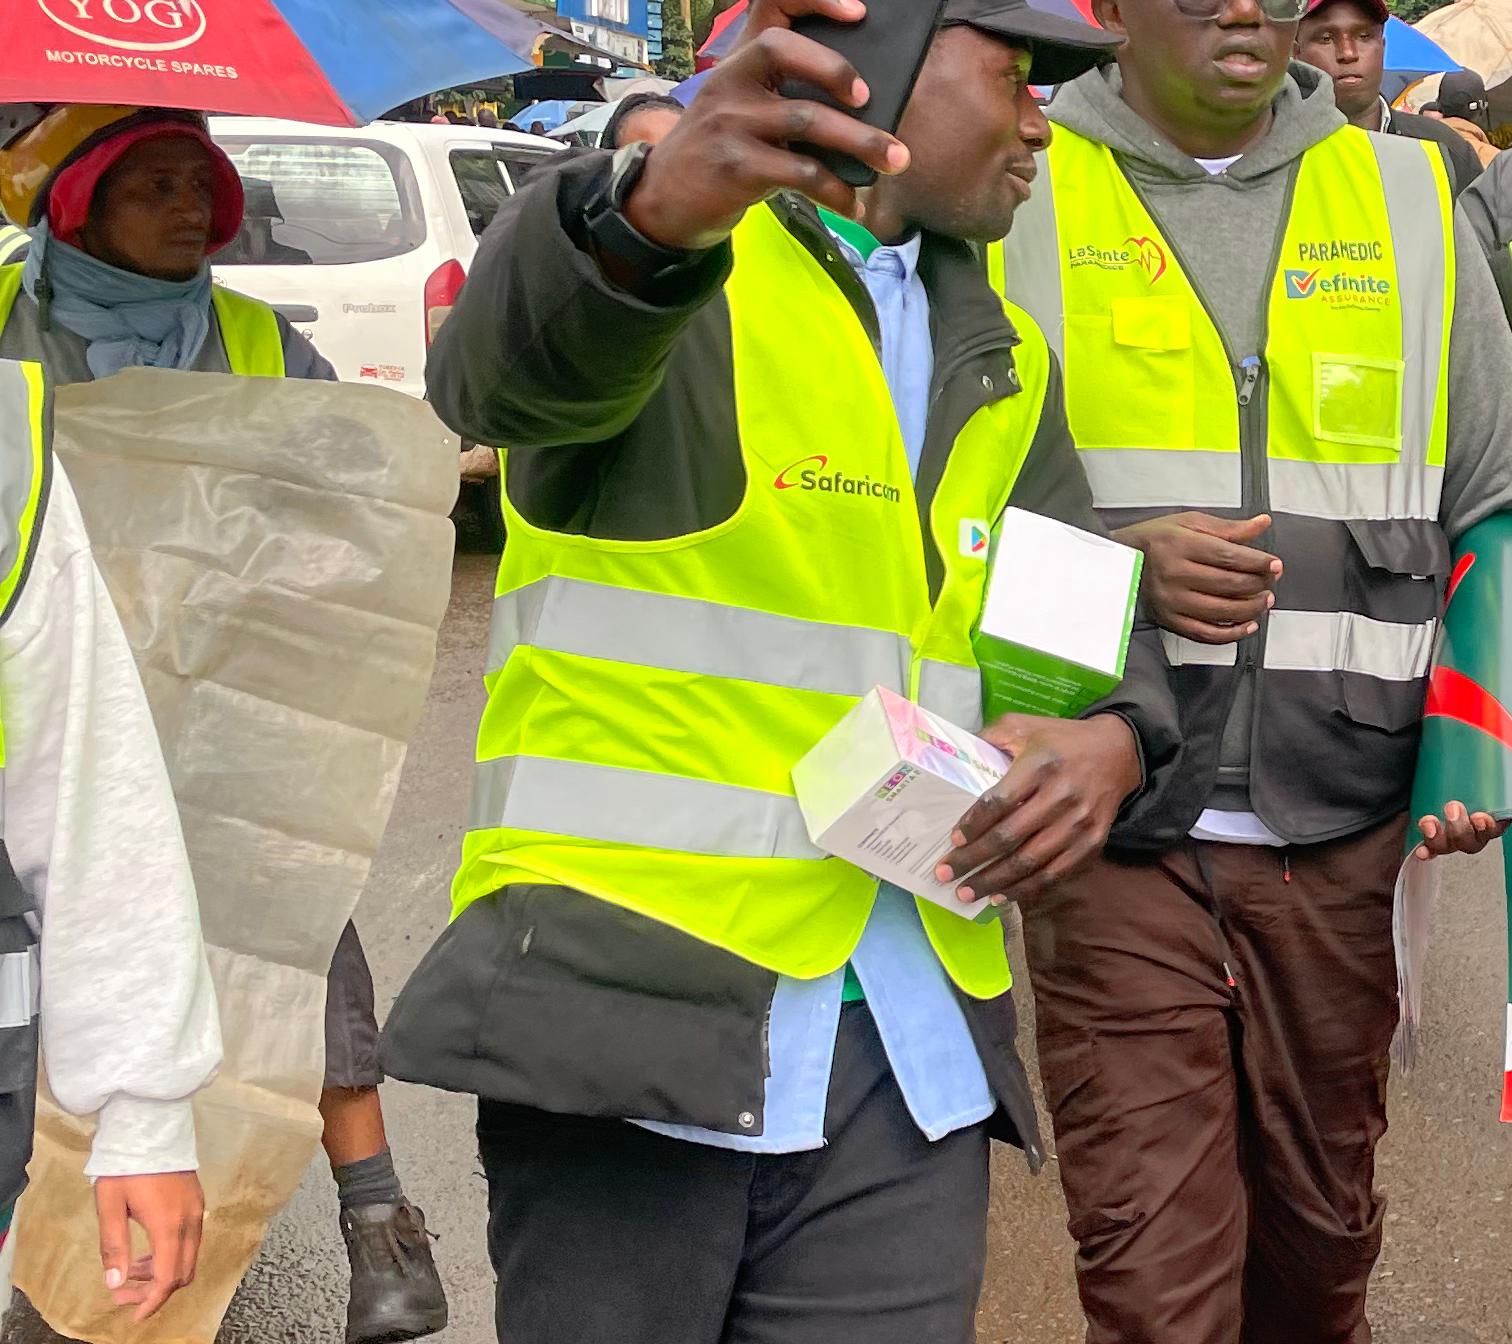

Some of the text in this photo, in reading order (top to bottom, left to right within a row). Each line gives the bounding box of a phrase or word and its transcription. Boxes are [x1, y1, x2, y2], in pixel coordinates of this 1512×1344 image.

[45, 49, 239, 79] MOTORCYCLE SPARES
[1298, 239, 1383, 262] PARAMEDIC
[1320, 294, 1391, 306] ASSURANCE
